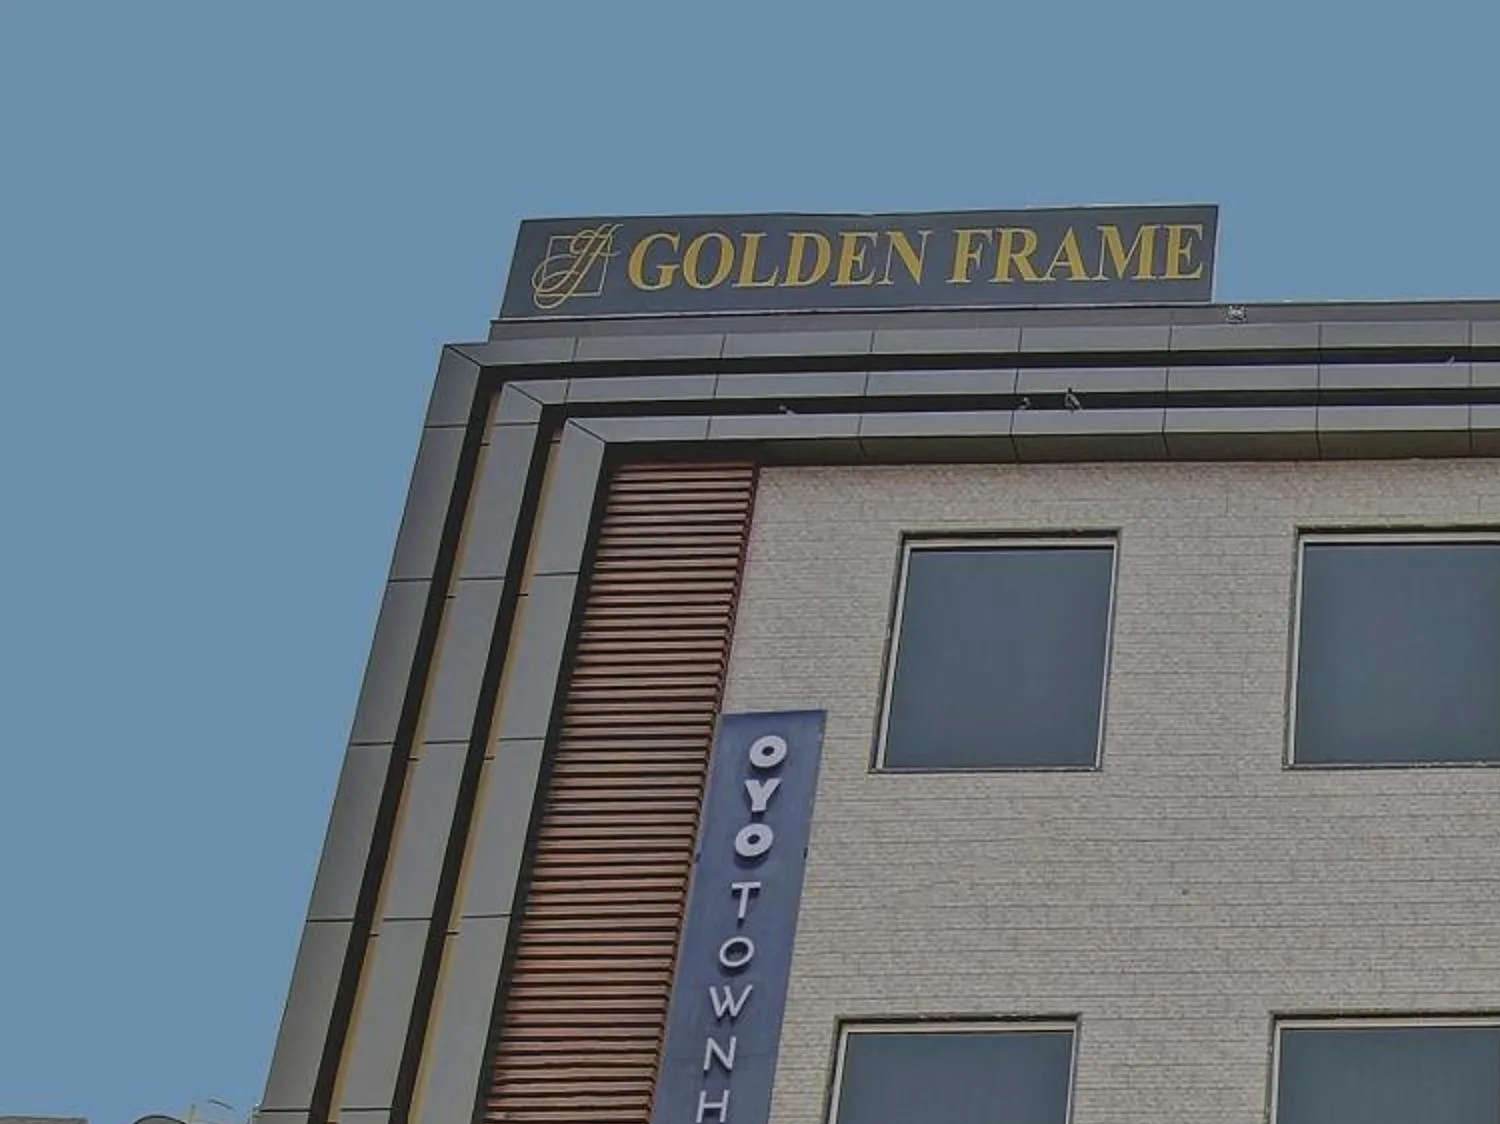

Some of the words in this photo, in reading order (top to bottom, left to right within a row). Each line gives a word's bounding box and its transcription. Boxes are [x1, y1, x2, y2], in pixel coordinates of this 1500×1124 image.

[627, 230, 930, 291] GOLDEN
[946, 223, 1204, 284] FRAME
[734, 735, 788, 857] OYO
